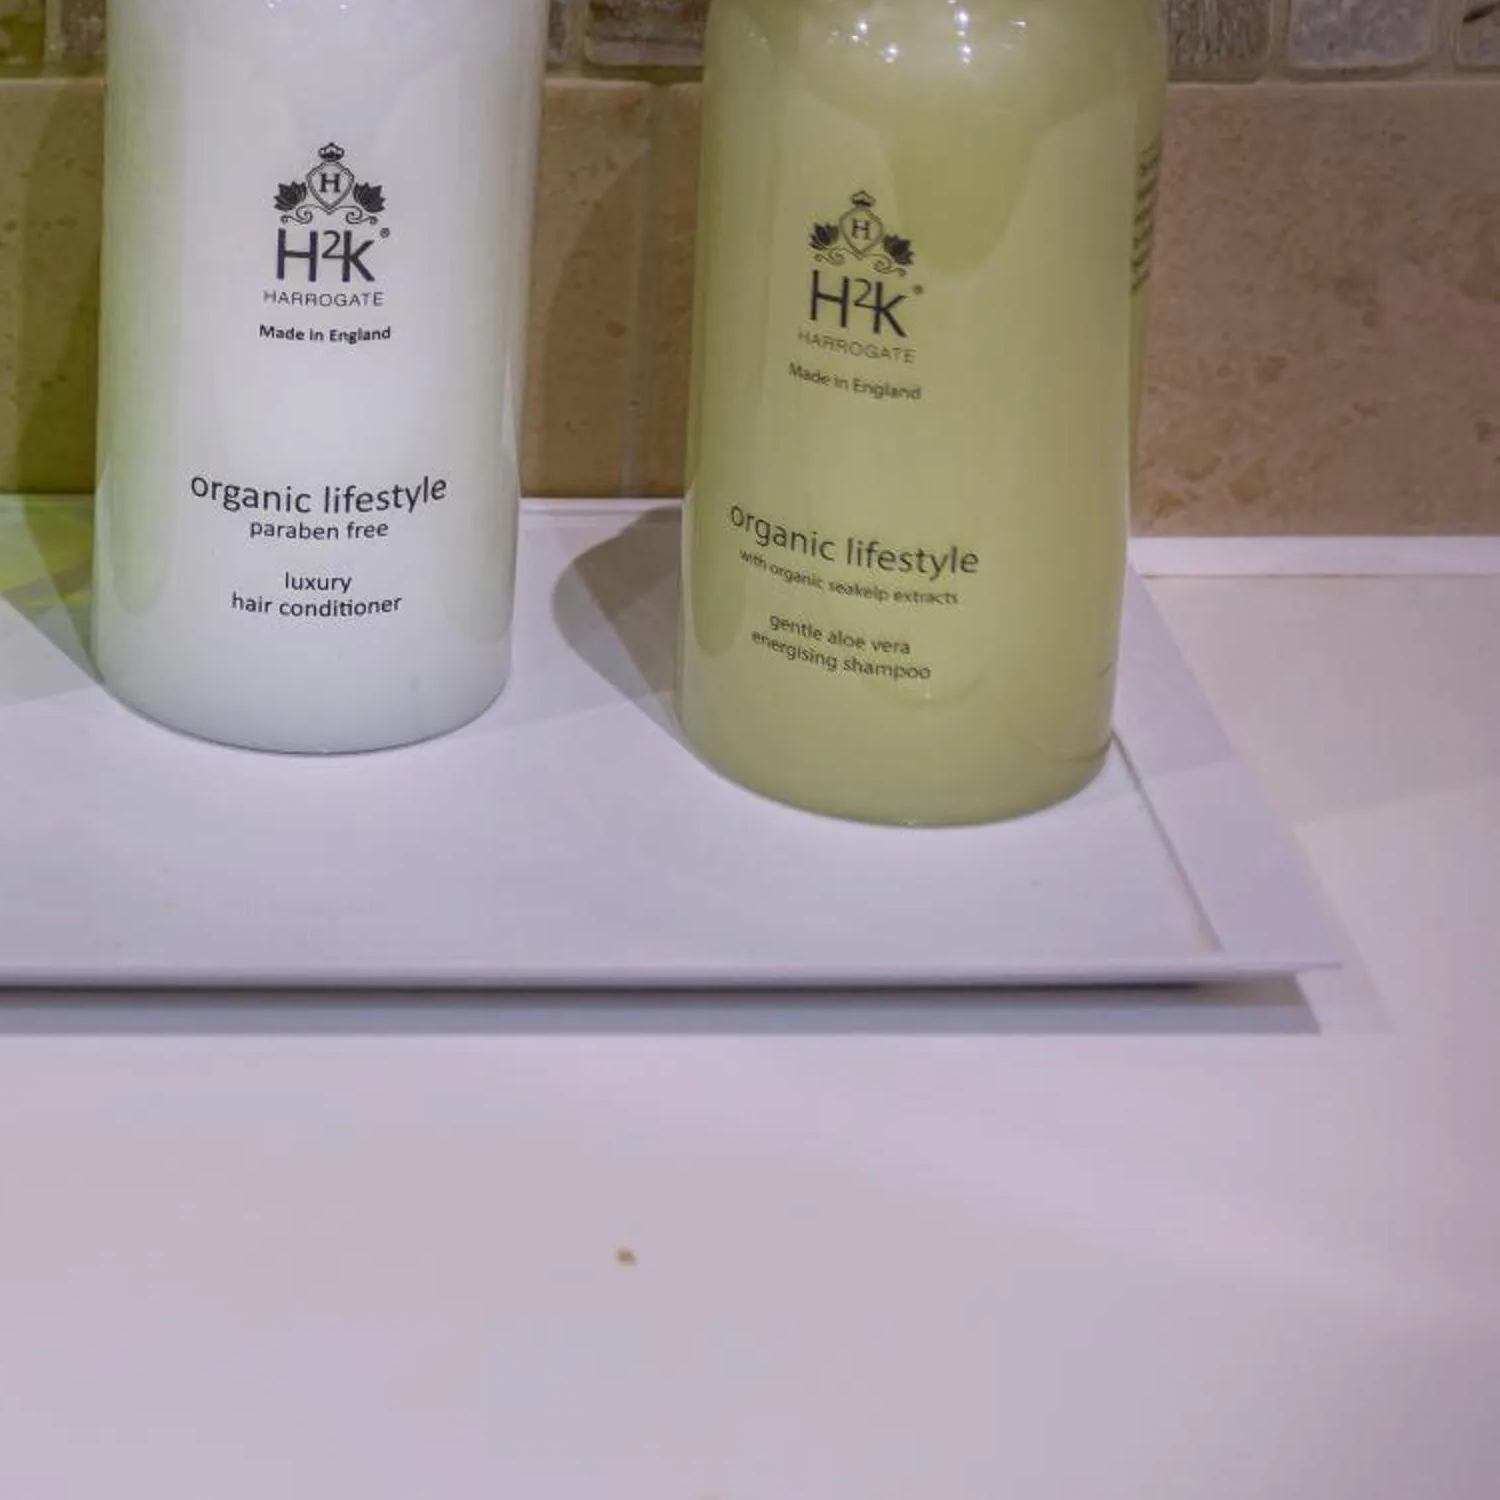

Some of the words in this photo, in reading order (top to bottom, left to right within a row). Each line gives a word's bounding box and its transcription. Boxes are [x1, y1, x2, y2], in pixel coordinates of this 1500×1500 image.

[320, 172, 341, 193] H
[851, 218, 872, 241] H
[262, 289, 385, 308] HARROGATE
[259, 324, 305, 342] Made
[309, 324, 325, 342] in
[329, 326, 392, 345] England
[797, 331, 917, 365] HARROGATE
[788, 362, 831, 387] Made
[833, 373, 849, 391] in
[853, 377, 922, 400] England
[190, 475, 312, 513] organic
[323, 475, 448, 514] lifestyle
[249, 521, 340, 541] paraben
[347, 520, 389, 540] free
[729, 504, 837, 562] organic
[846, 536, 980, 582] lifestyle
[284, 571, 353, 594] luxury
[739, 548, 768, 572] with
[768, 562, 825, 591] organic
[893, 589, 959, 605] extracts
[231, 590, 273, 614] hair
[278, 595, 403, 618] conditioner
[768, 613, 824, 642] gentle
[827, 629, 867, 651] aloe
[870, 637, 912, 656] vera
[751, 629, 839, 673] energising
[843, 655, 932, 681] shampoo
